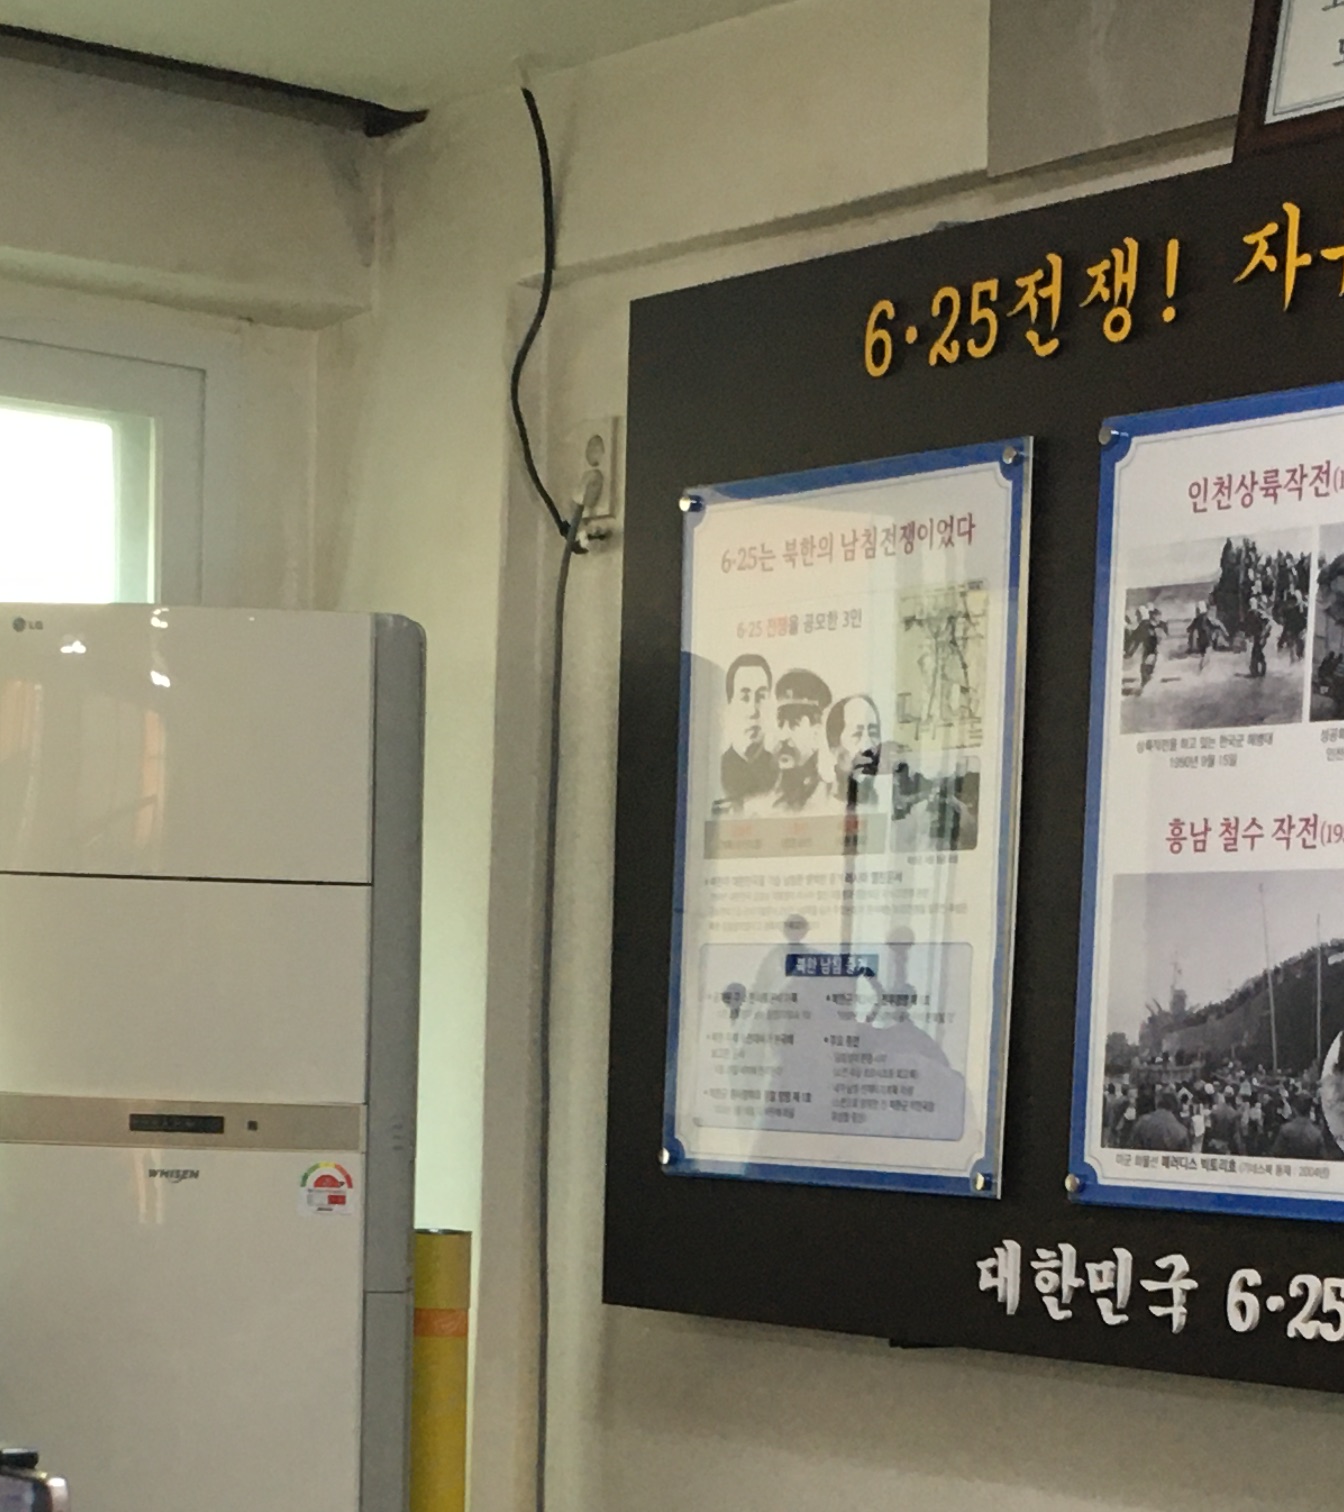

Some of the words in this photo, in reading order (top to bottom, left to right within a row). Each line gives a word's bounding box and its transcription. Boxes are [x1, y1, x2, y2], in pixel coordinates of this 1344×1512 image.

[864, 236, 1180, 378] 6·25전쟁!
[782, 530, 835, 571] 북한의
[840, 512, 977, 562] 남침전쟁이었다
[1165, 815, 1212, 856] 흥남
[1218, 814, 1265, 854] 철수
[976, 1239, 1199, 1335] 대한민국
